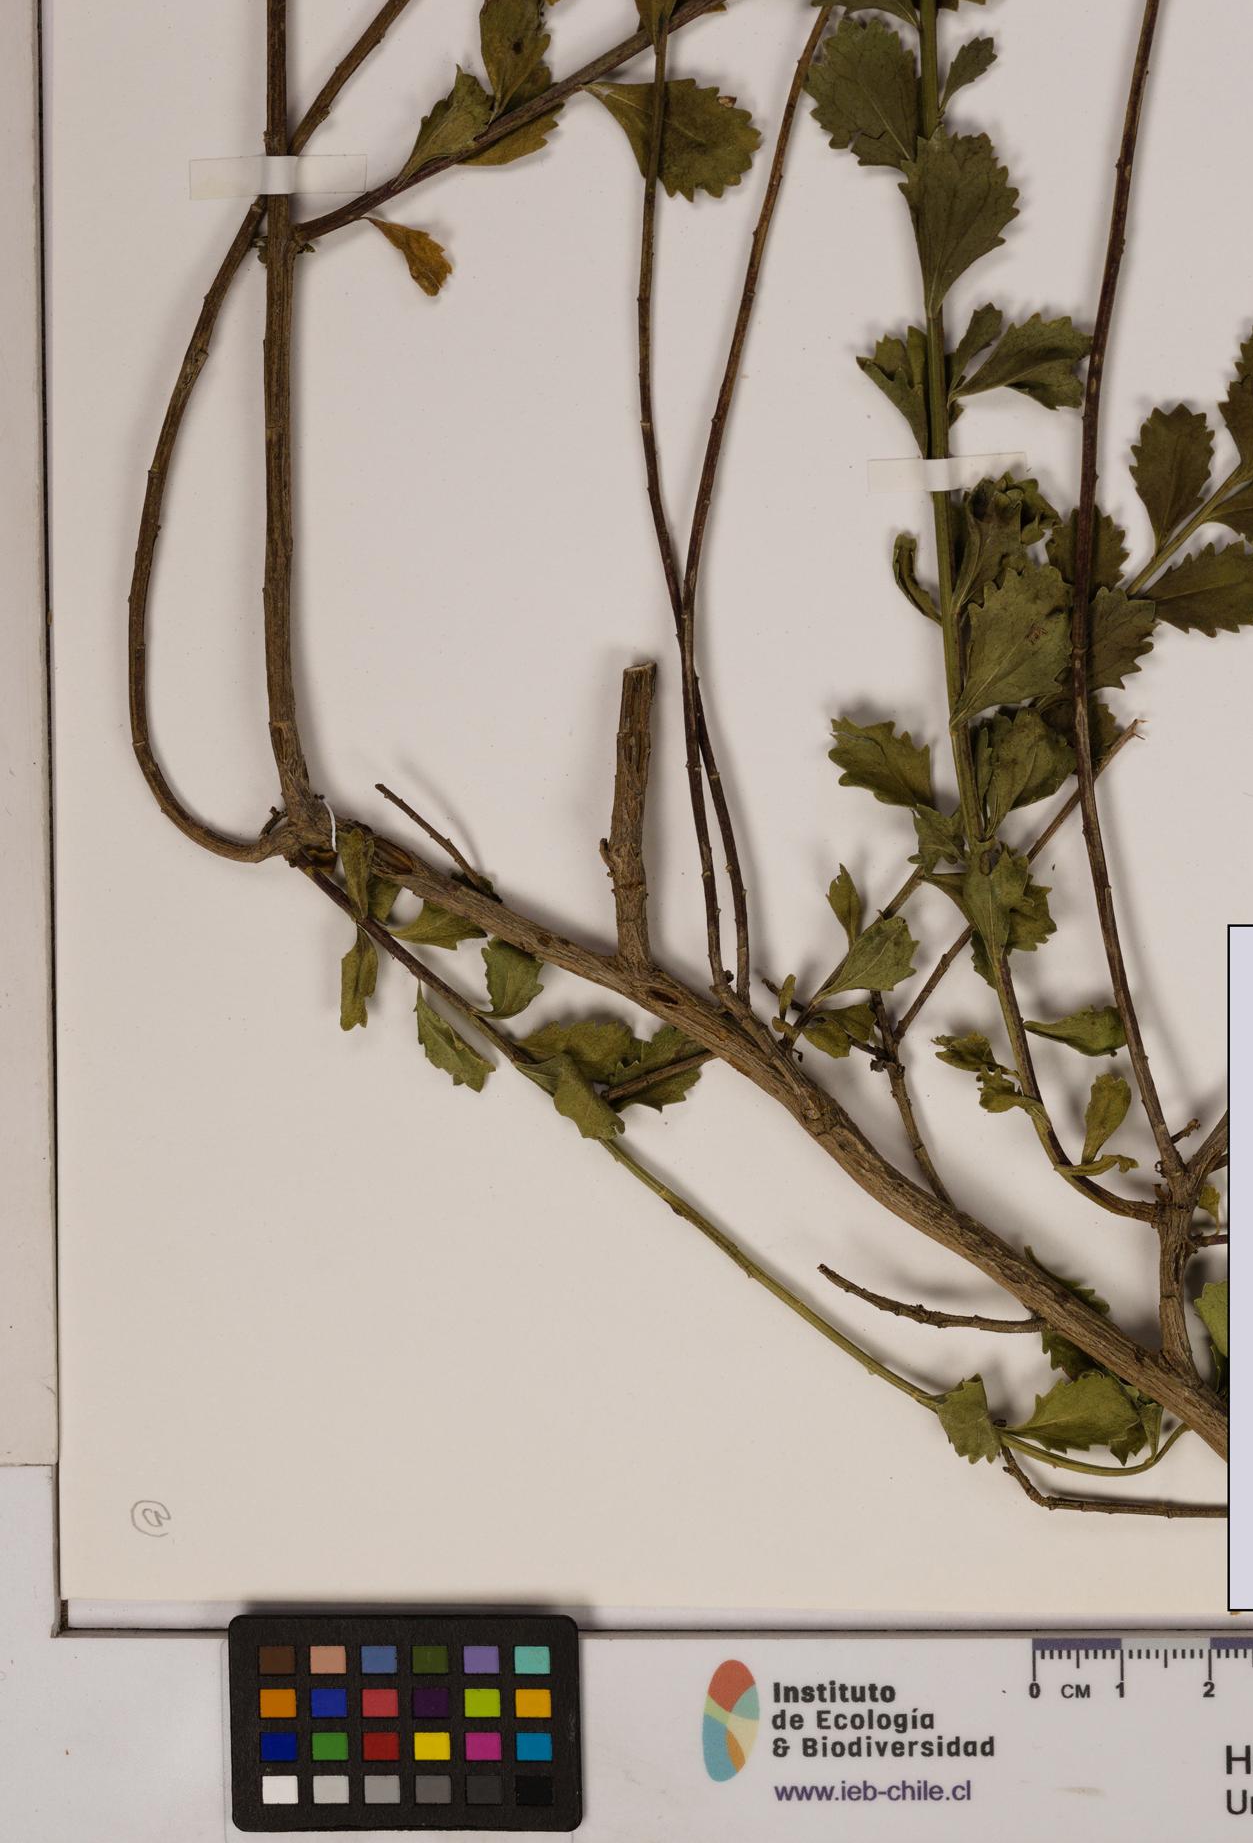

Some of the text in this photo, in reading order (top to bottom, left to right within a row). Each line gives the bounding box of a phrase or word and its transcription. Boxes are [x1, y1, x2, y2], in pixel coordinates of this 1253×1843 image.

[772, 1680, 897, 1704] Instituto
[1028, 1682, 1042, 1699] 0
[1060, 1683, 1091, 1700] CM
[1115, 1682, 1125, 1698] 1
[1202, 1681, 1216, 1697] 2
[771, 1707, 935, 1735] de Ecología
[772, 1735, 995, 1758] & Biodiversidad
[773, 1779, 972, 1802] www.ieb-chile.cl
